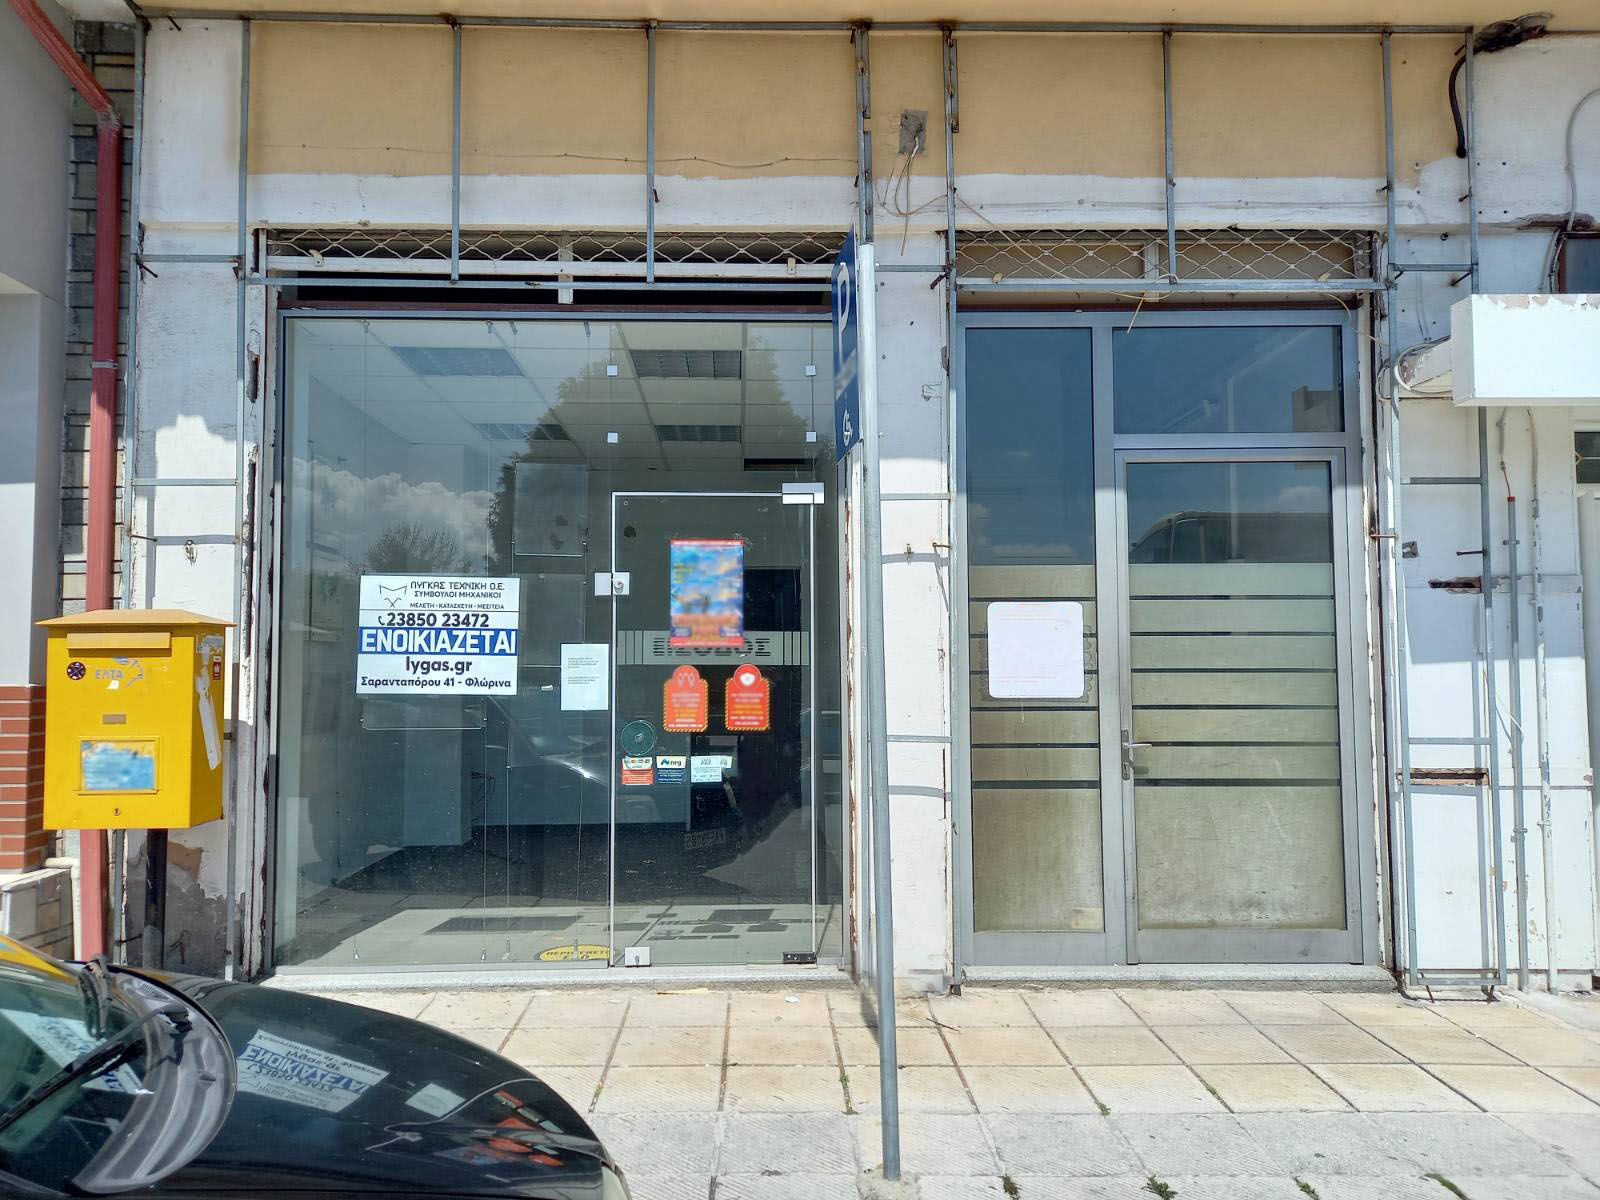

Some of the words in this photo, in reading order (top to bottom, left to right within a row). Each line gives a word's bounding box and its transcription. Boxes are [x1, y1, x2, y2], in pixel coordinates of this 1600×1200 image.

[448, 581, 487, 590] ΤΕΧΝΙΚΗ
[489, 582, 505, 591] Ο.Ε.
[414, 590, 457, 598] ΣΥΜΒΟΥΛΟΙ
[459, 591, 502, 599] ΜΗΧΑΝΙΚΟΙ
[386, 612, 437, 627] 23850
[441, 613, 490, 628] 23472
[361, 628, 516, 654] ΕΝΟΙΚΙΑΖΕΤΑΙ
[405, 656, 473, 676] lygas.gr
[360, 676, 441, 689] Σαρανταπόρου
[443, 677, 455, 687] 41
[465, 677, 512, 690] Φλώρινα
